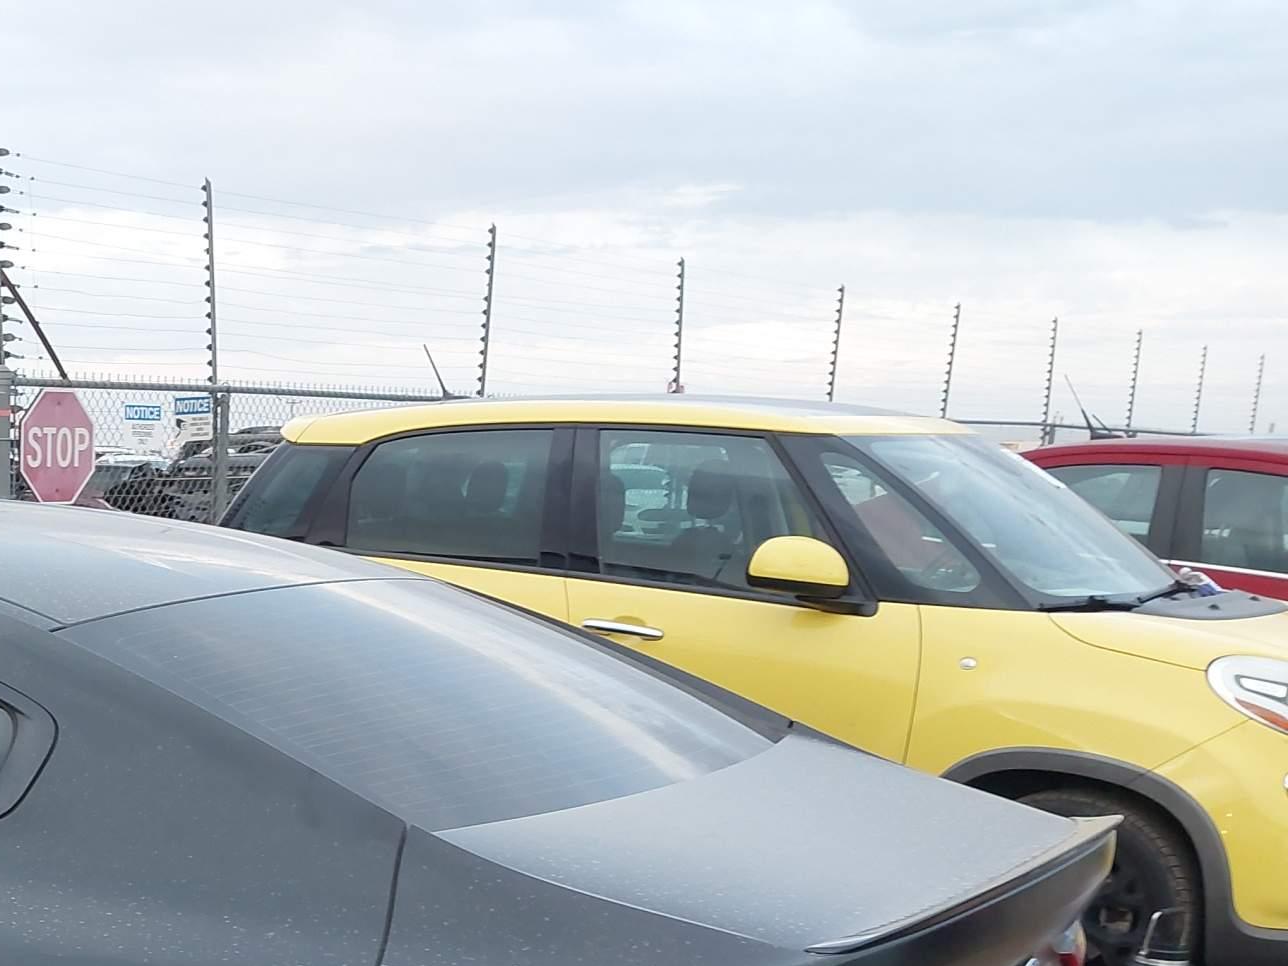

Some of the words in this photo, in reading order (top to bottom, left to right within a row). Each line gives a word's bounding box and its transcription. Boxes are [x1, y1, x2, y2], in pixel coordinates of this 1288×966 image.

[125, 406, 161, 419] NOTICE
[175, 398, 210, 413] NOTICE
[26, 426, 91, 468] STOP
